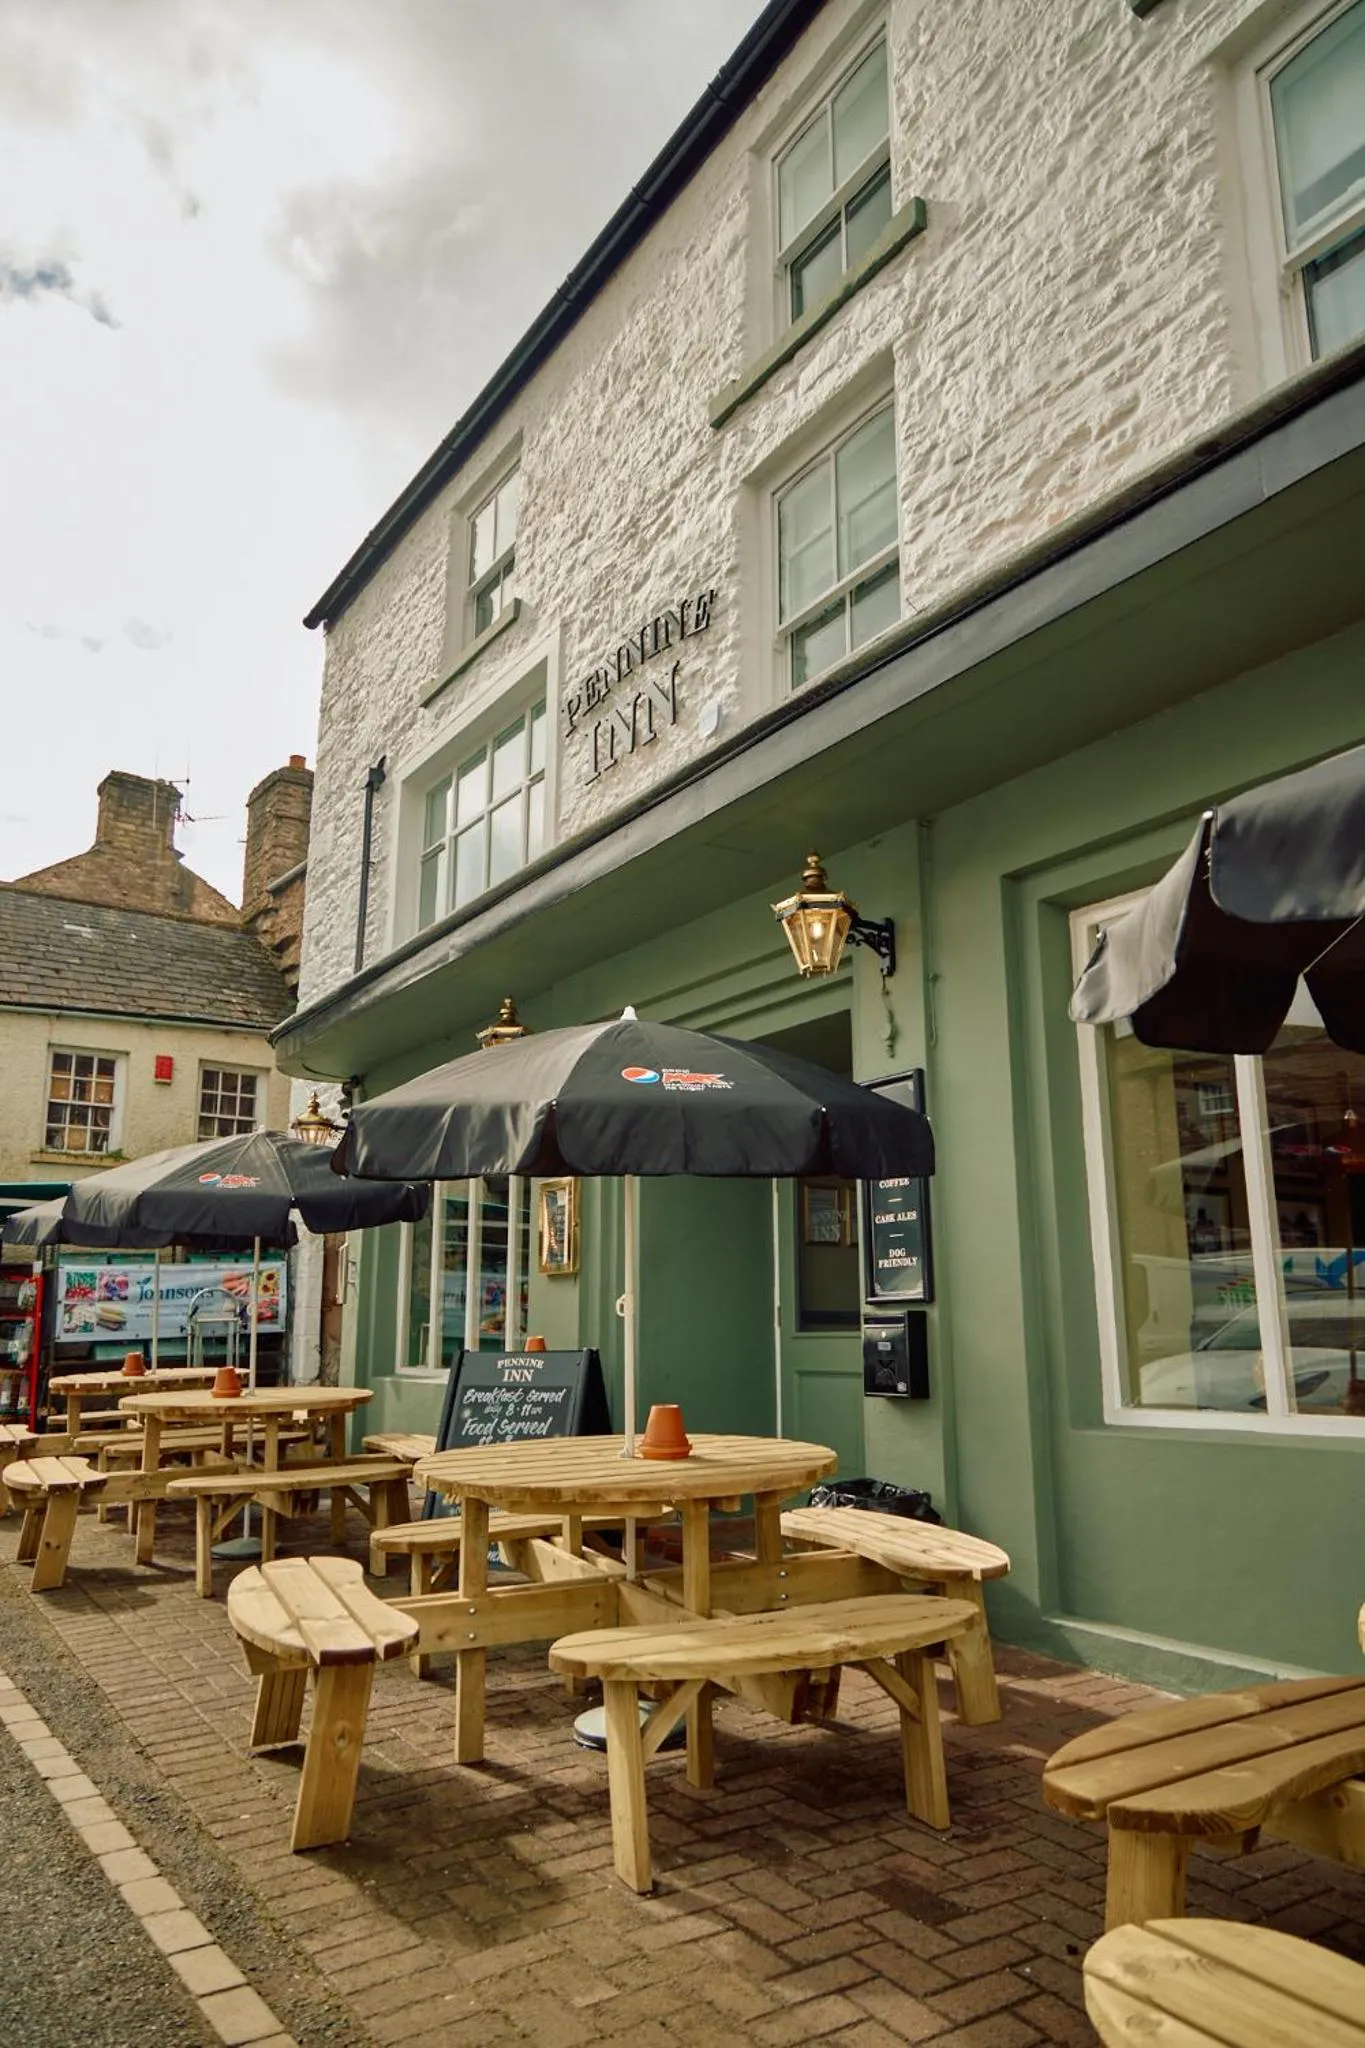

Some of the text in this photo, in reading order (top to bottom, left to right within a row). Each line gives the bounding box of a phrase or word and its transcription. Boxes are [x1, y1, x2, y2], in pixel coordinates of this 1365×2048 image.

[561, 589, 718, 738] PENNINE
[585, 660, 681, 786] INN
[875, 1211, 917, 1224] CASK ALES
[889, 1248, 906, 1257] DOG
[878, 1257, 917, 1268] FRIENDLY
[497, 1358, 544, 1368] PENNINE
[503, 1369, 534, 1382] INN
[463, 1386, 524, 1404] Breakfast
[462, 1417, 553, 1435] Food Served
